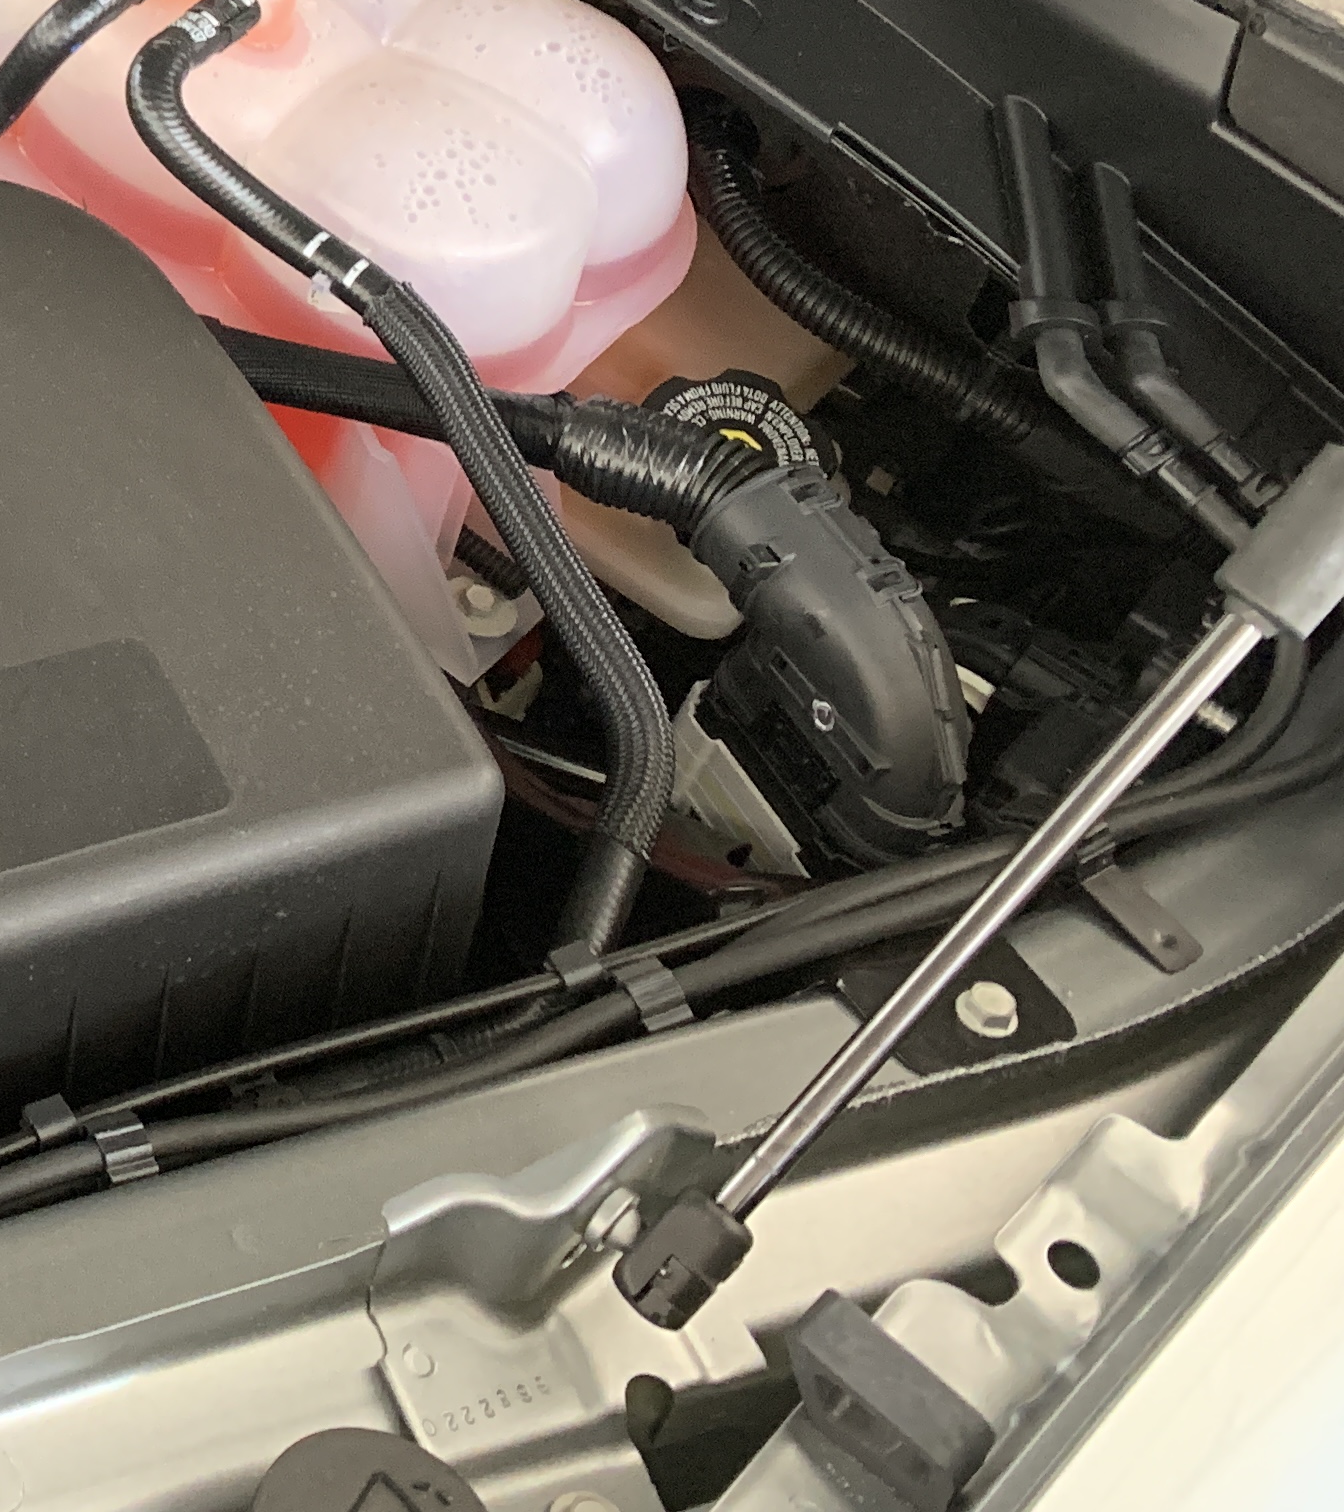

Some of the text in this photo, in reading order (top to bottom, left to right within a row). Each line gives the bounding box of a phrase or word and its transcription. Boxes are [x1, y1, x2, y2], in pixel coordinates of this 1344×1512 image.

[682, 383, 711, 402] FROM
[711, 381, 741, 398] FLUID
[744, 399, 764, 415] CAP
